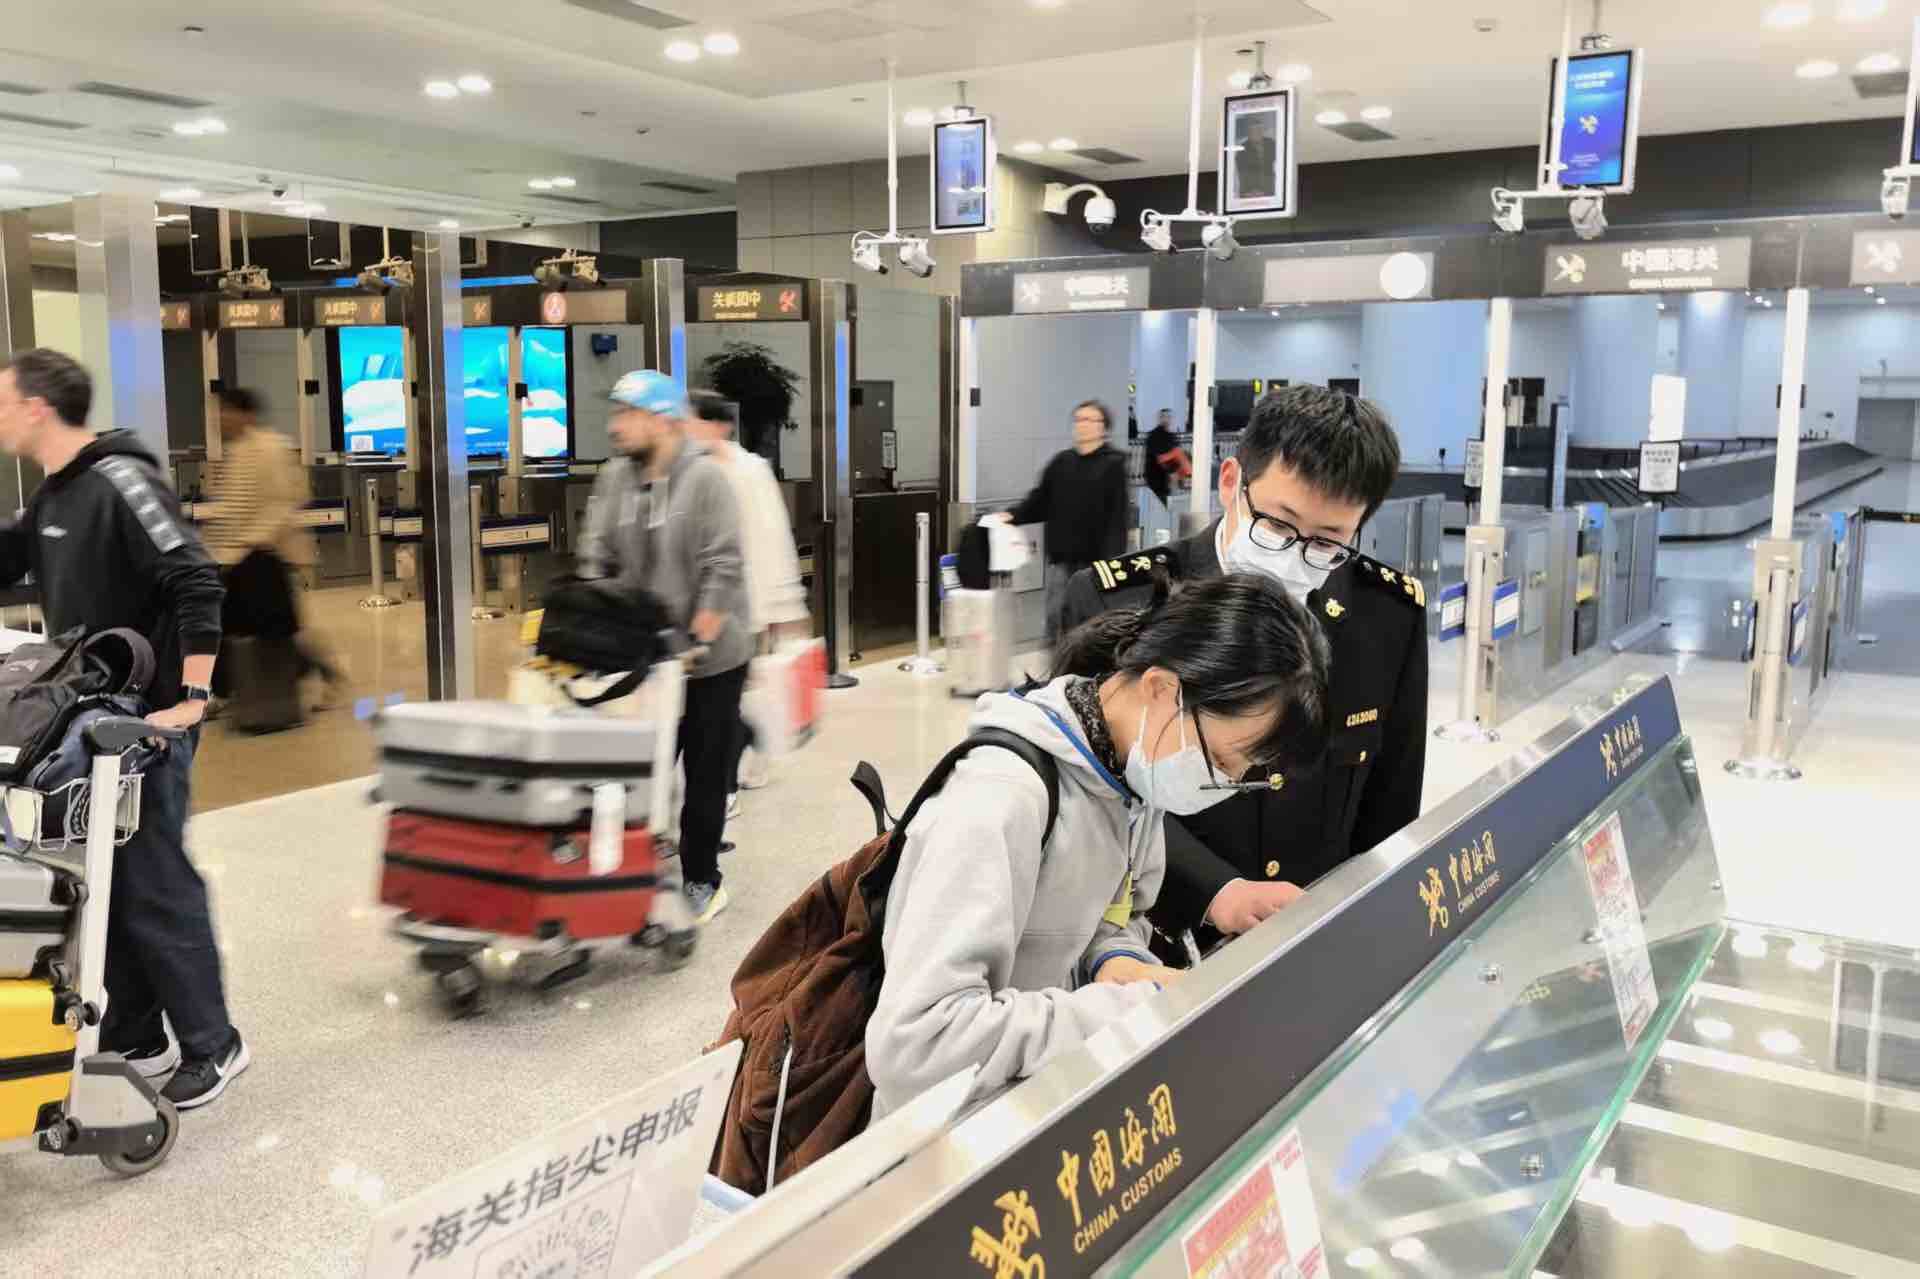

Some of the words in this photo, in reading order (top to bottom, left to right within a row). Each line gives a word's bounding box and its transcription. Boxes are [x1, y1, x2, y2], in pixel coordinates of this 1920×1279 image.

[406, 1084, 704, 1276] 海关指尖申报
[1072, 1202, 1120, 1255] CHINA
[1119, 1147, 1185, 1213] CUSTOMS
